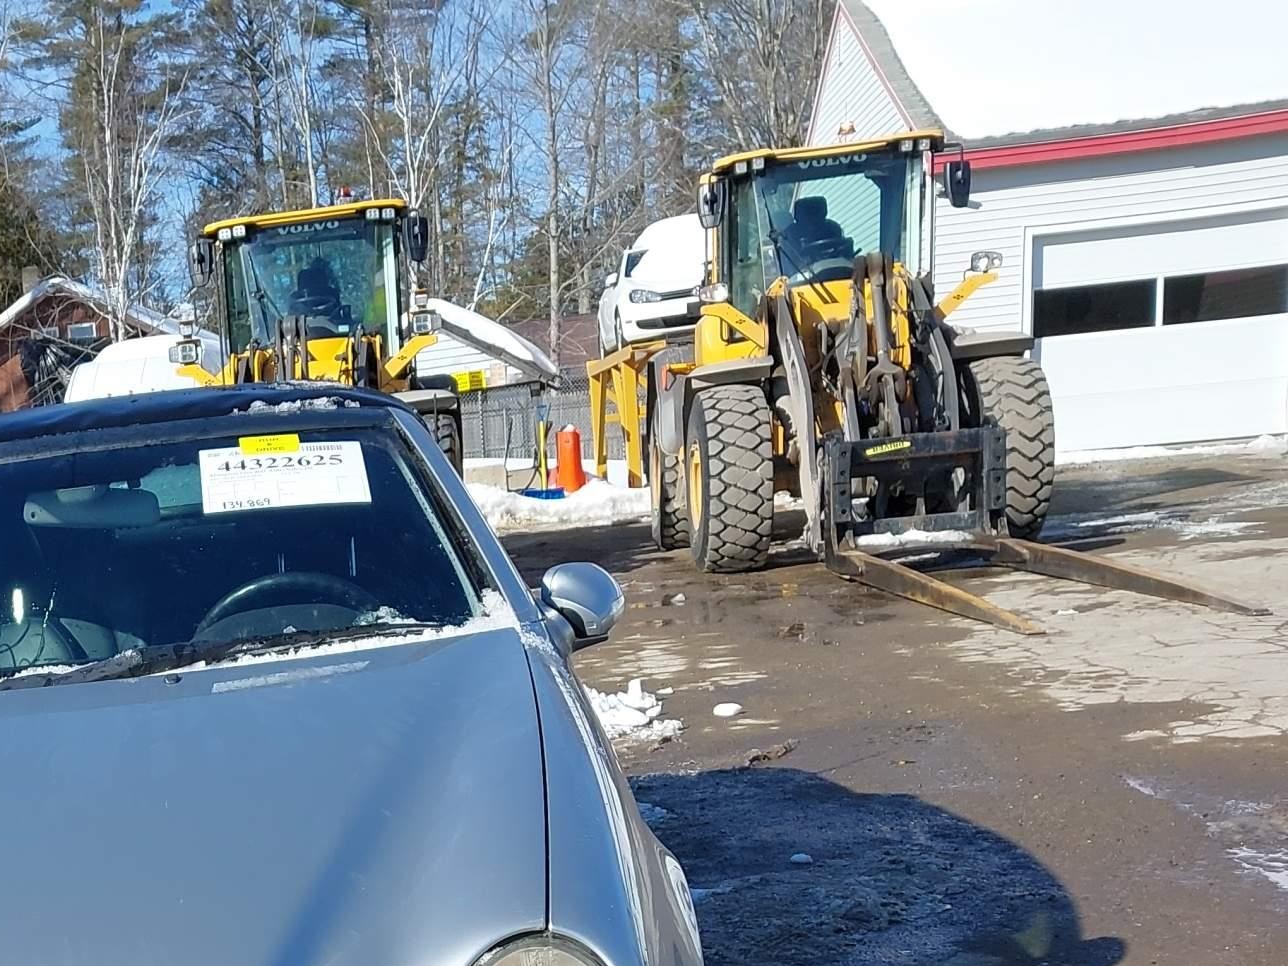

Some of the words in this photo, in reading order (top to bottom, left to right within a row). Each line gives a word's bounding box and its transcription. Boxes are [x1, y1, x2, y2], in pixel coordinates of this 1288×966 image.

[798, 153, 867, 169] VOLVO
[278, 220, 340, 235] VOLVO
[217, 454, 343, 472] 44322625
